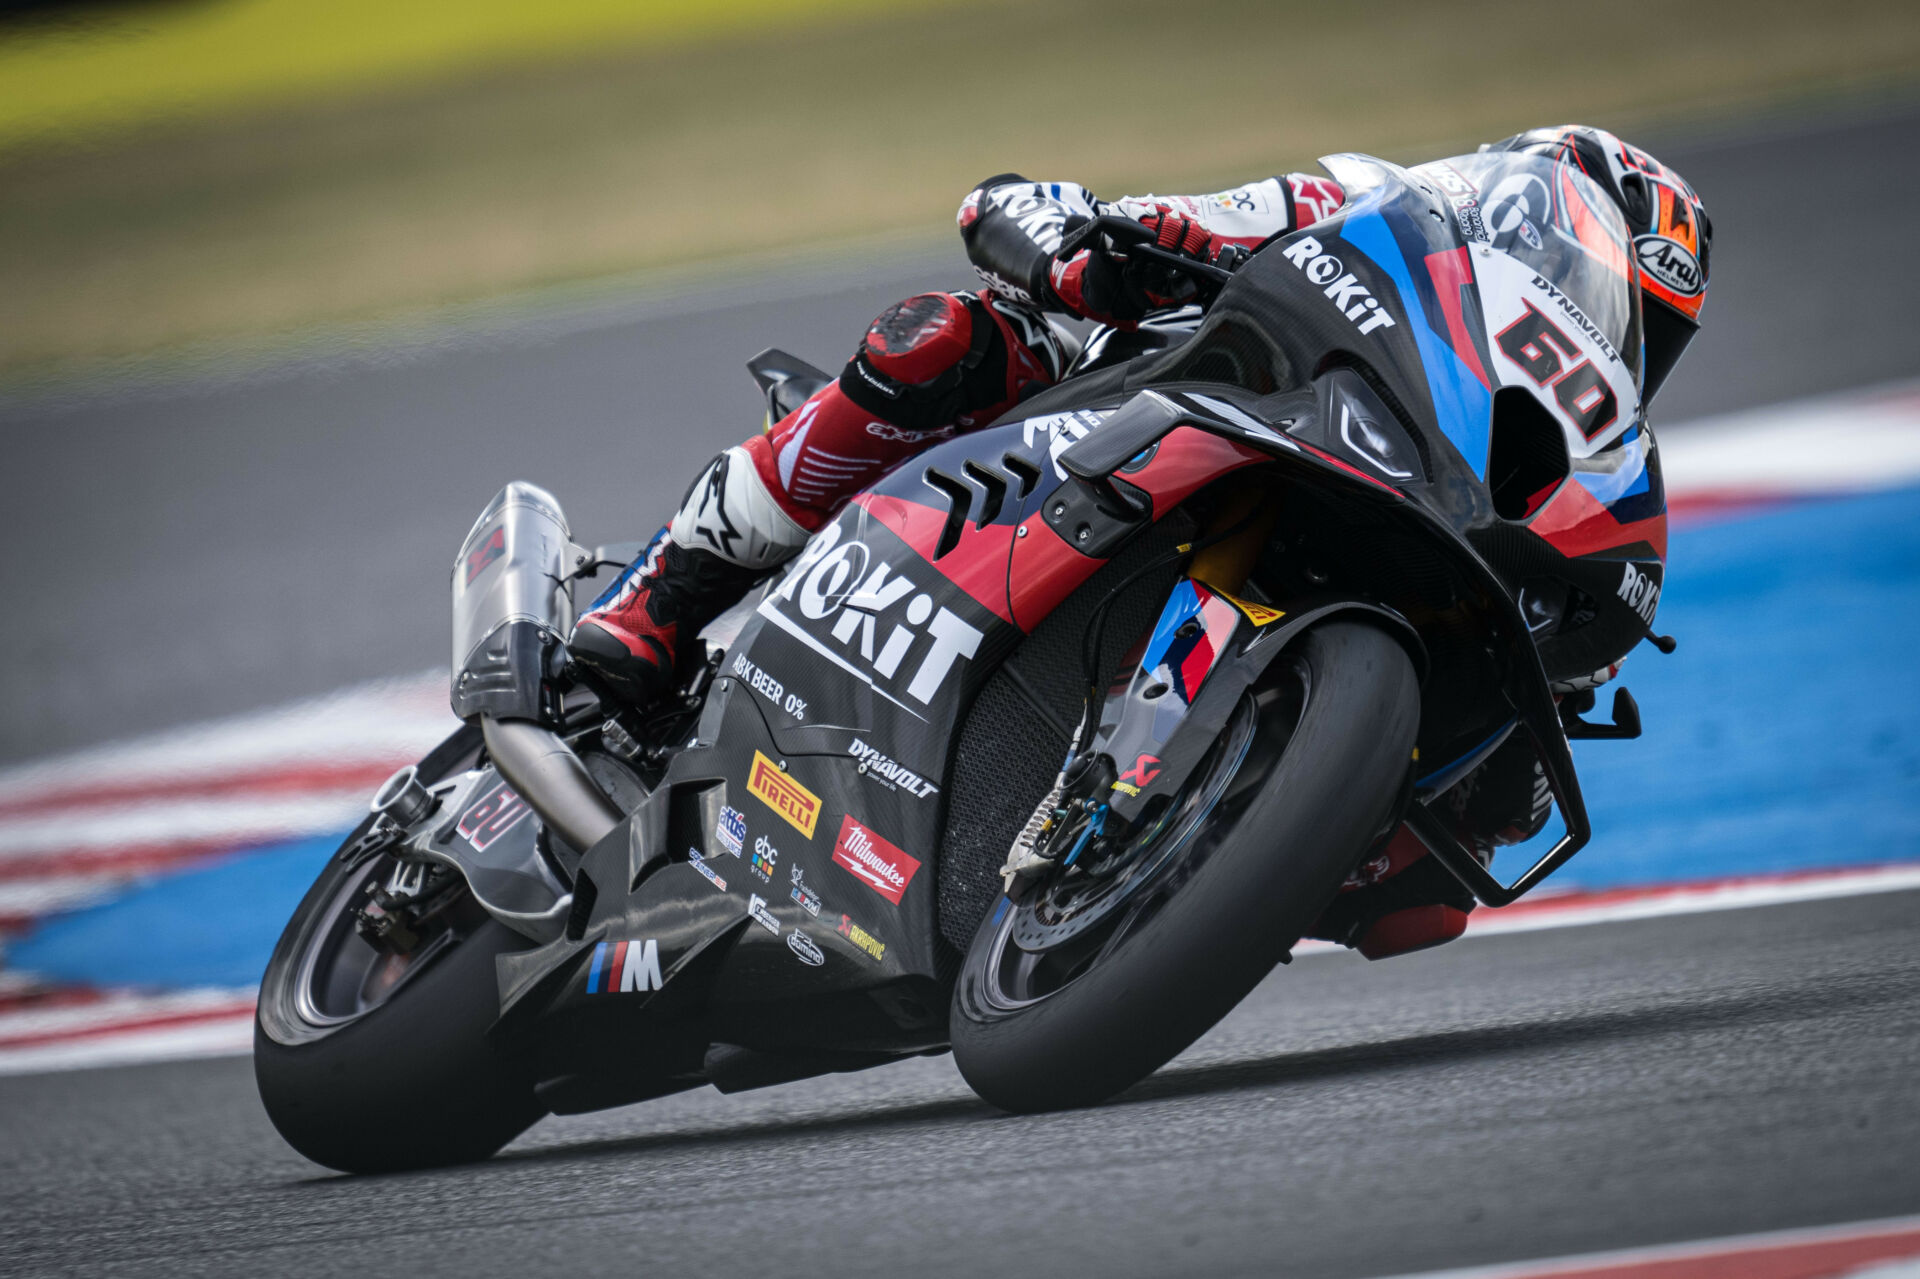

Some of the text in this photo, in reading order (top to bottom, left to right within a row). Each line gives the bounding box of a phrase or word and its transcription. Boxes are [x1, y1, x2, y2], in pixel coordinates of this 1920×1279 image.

[1282, 235, 1395, 336] ROKiT
[1638, 243, 1698, 287] Arai
[1531, 275, 1620, 363] DYNAVOLT
[1494, 297, 1618, 443] 60
[774, 520, 984, 705] ROKiT
[733, 652, 807, 720] ABK BEER 0%
[753, 760, 815, 829] PIRELLI
[848, 738, 939, 798] DYNAVOLT
[719, 806, 746, 842] attis
[755, 835, 778, 865] ebc
[751, 865, 770, 883] group
[843, 824, 905, 888] Milwaukee
[804, 898, 818, 913] PVM
[620, 939, 663, 992] M
[790, 936, 821, 964] domino
